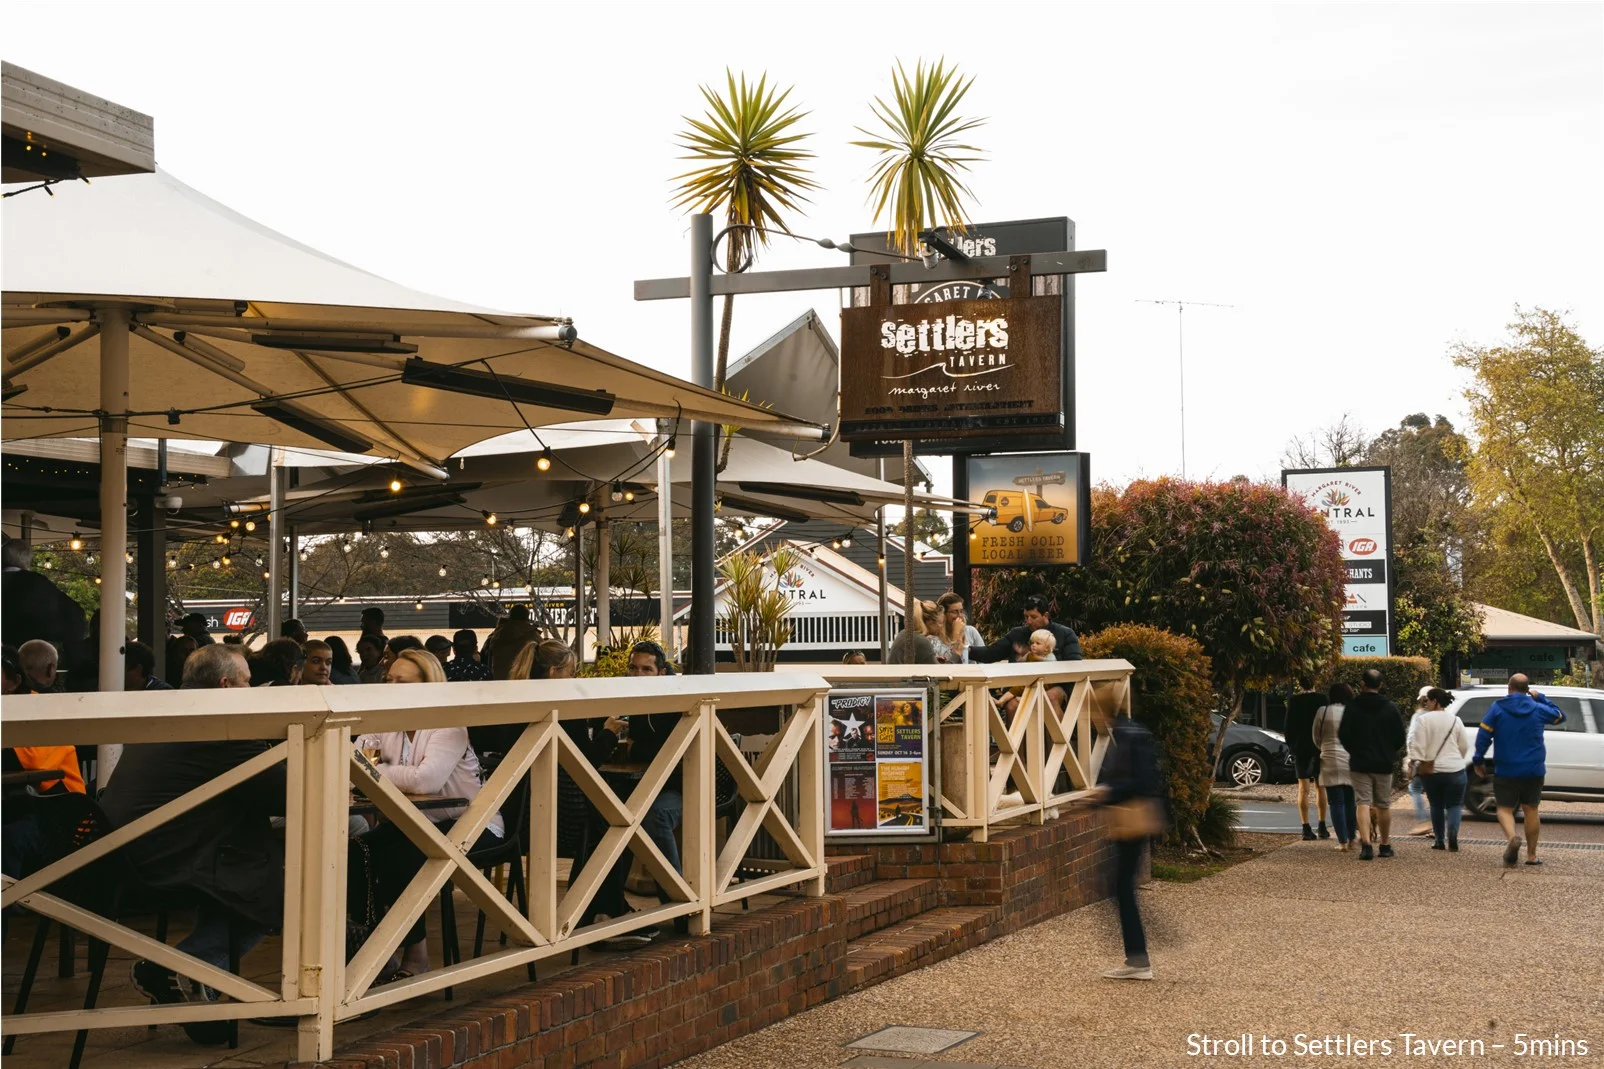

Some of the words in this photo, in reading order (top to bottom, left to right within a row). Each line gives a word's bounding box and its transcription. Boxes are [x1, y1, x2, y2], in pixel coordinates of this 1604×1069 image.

[950, 353, 1007, 368] TAVERN
[888, 380, 957, 399] margaret
[964, 381, 1001, 392] river
[1311, 480, 1342, 498] MARGARET
[1344, 482, 1362, 496] RIVER
[1320, 507, 1376, 518] NTRAL
[982, 536, 1025, 548] FRESH
[1351, 541, 1376, 552] IGA
[982, 549, 1023, 560] LOCAL
[1029, 548, 1065, 559] BEER
[1348, 568, 1373, 579] HANTS
[778, 590, 827, 600] NTRAL
[226, 611, 252, 626] IGA
[1352, 643, 1376, 653] cafe
[1529, 652, 1555, 663] cafe
